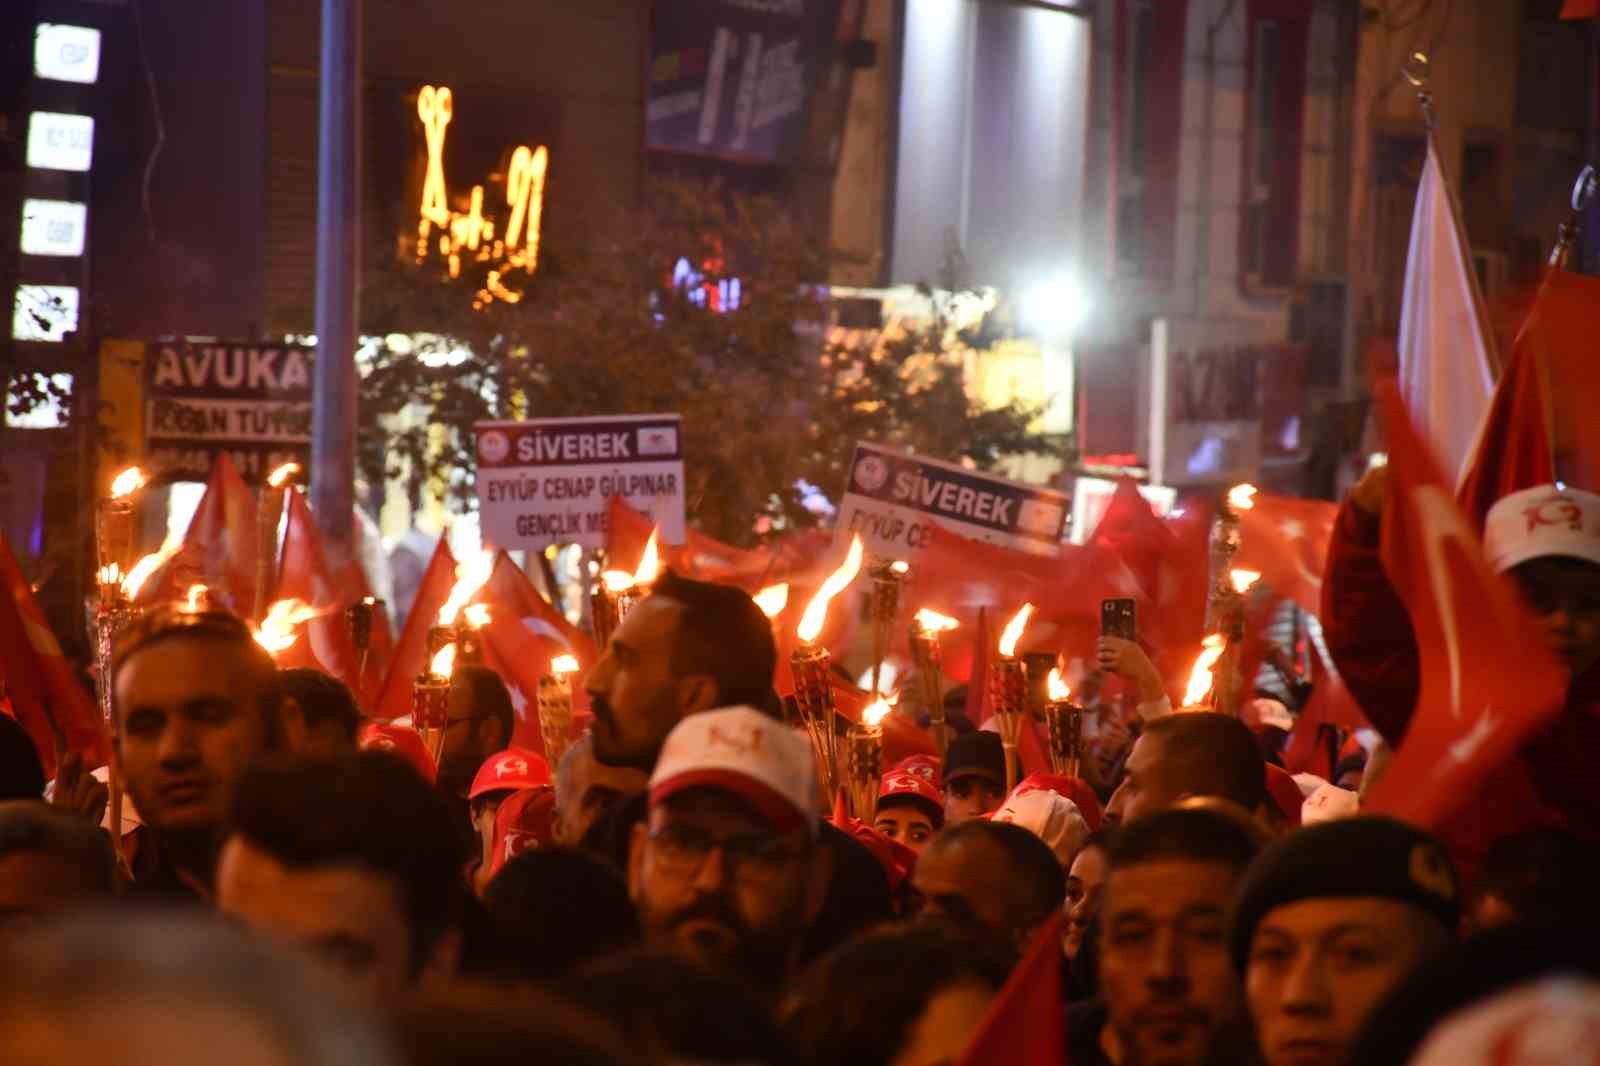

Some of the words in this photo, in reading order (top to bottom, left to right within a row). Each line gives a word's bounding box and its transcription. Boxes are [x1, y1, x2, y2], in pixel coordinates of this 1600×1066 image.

[154, 348, 313, 388] AVUKA
[517, 430, 631, 461] SİVEREK
[488, 473, 538, 501] EYYÜP
[543, 476, 596, 499] CENAP
[600, 469, 677, 497] GÜLPINAR
[893, 468, 1014, 525] SİVEREK
[516, 506, 581, 540] GENÇLİK
[586, 512, 609, 533] ME
[907, 522, 931, 549] CE
